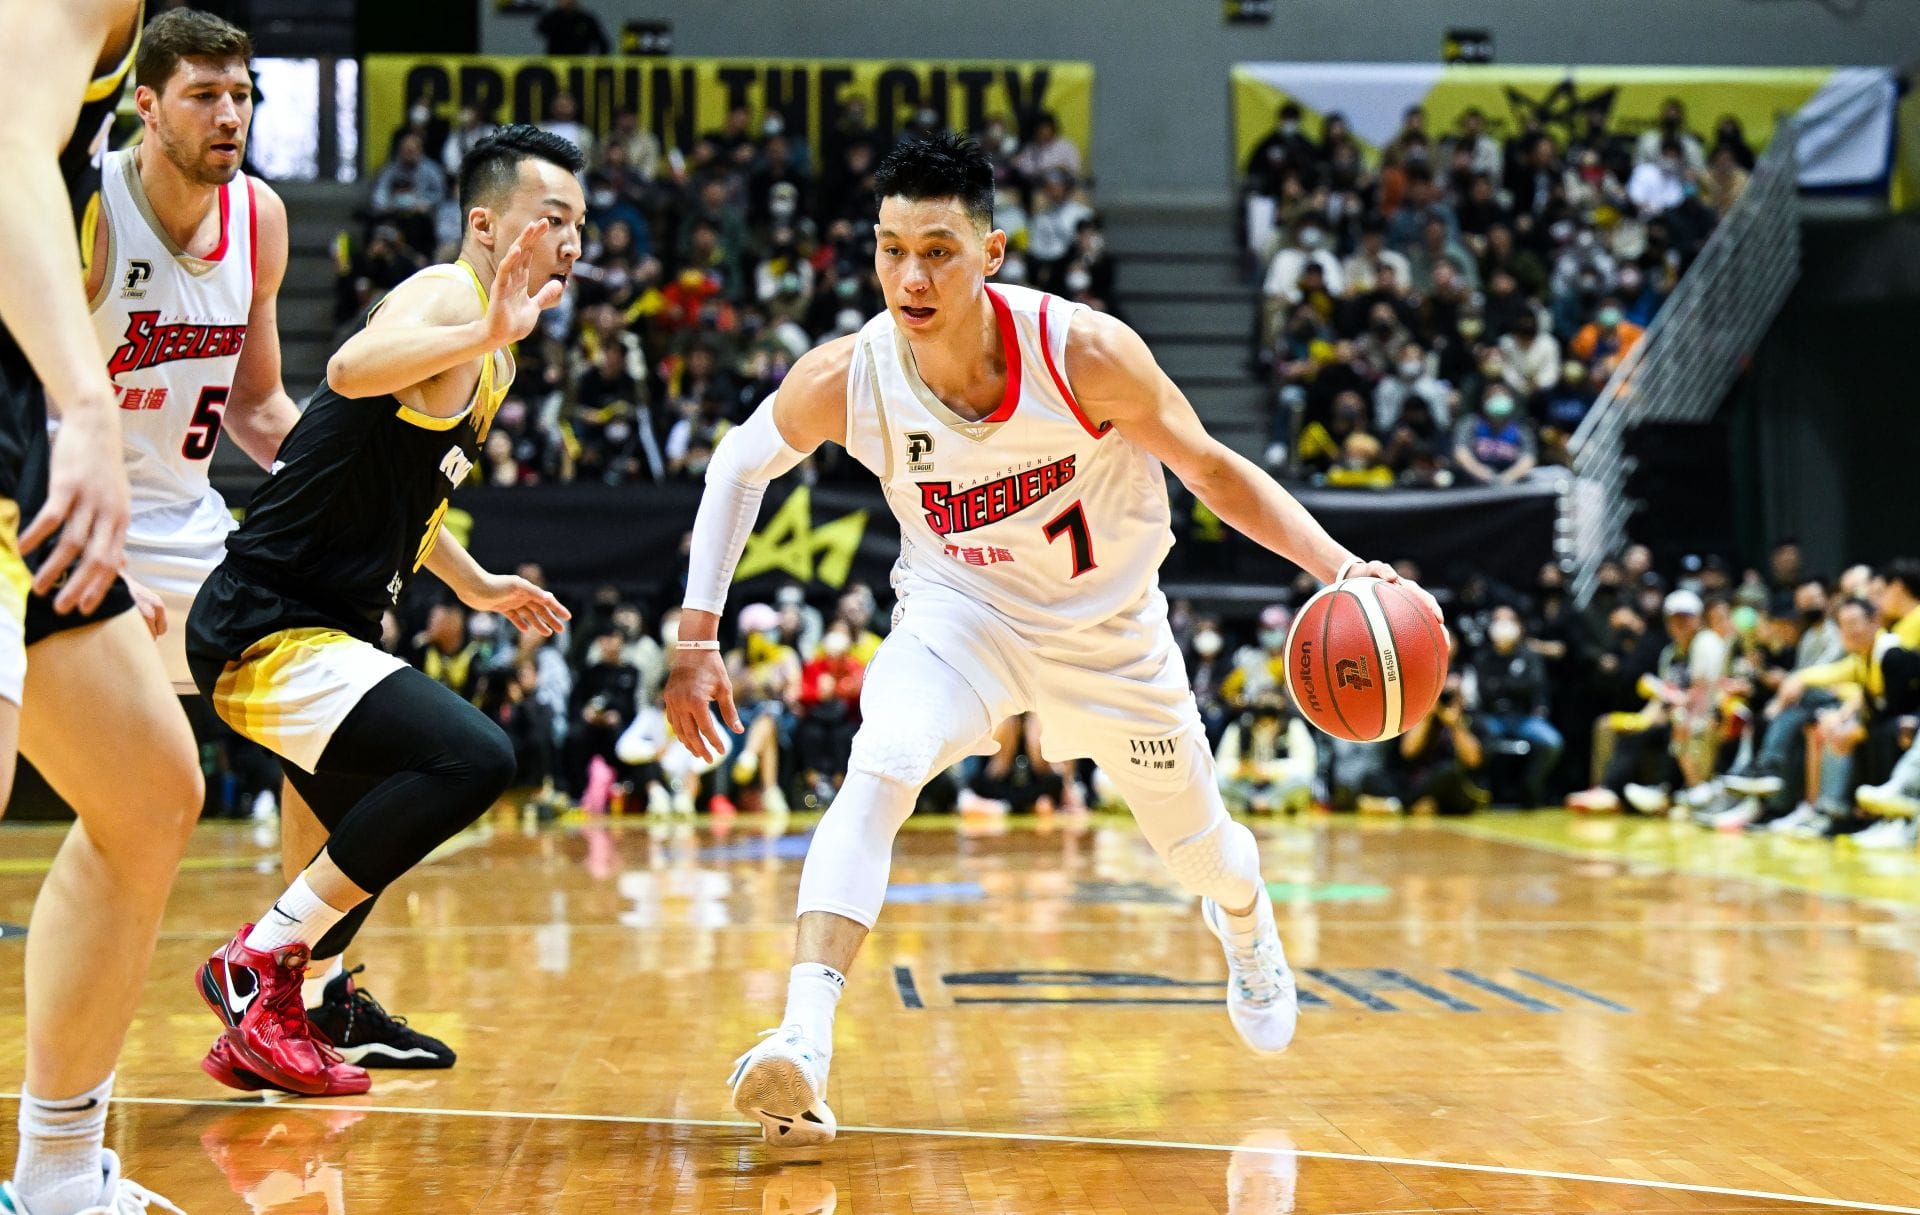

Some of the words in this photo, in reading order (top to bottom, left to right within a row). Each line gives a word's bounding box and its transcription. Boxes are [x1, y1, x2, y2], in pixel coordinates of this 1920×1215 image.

[718, 65, 853, 162] THE
[107, 310, 248, 382] STEELERS
[111, 383, 168, 410] 直播
[182, 385, 230, 460] 5
[915, 453, 1076, 539] STEELERS
[958, 456, 1053, 490] KAOHSIUNG
[1042, 499, 1099, 580] 7
[1300, 641, 1323, 713] molten
